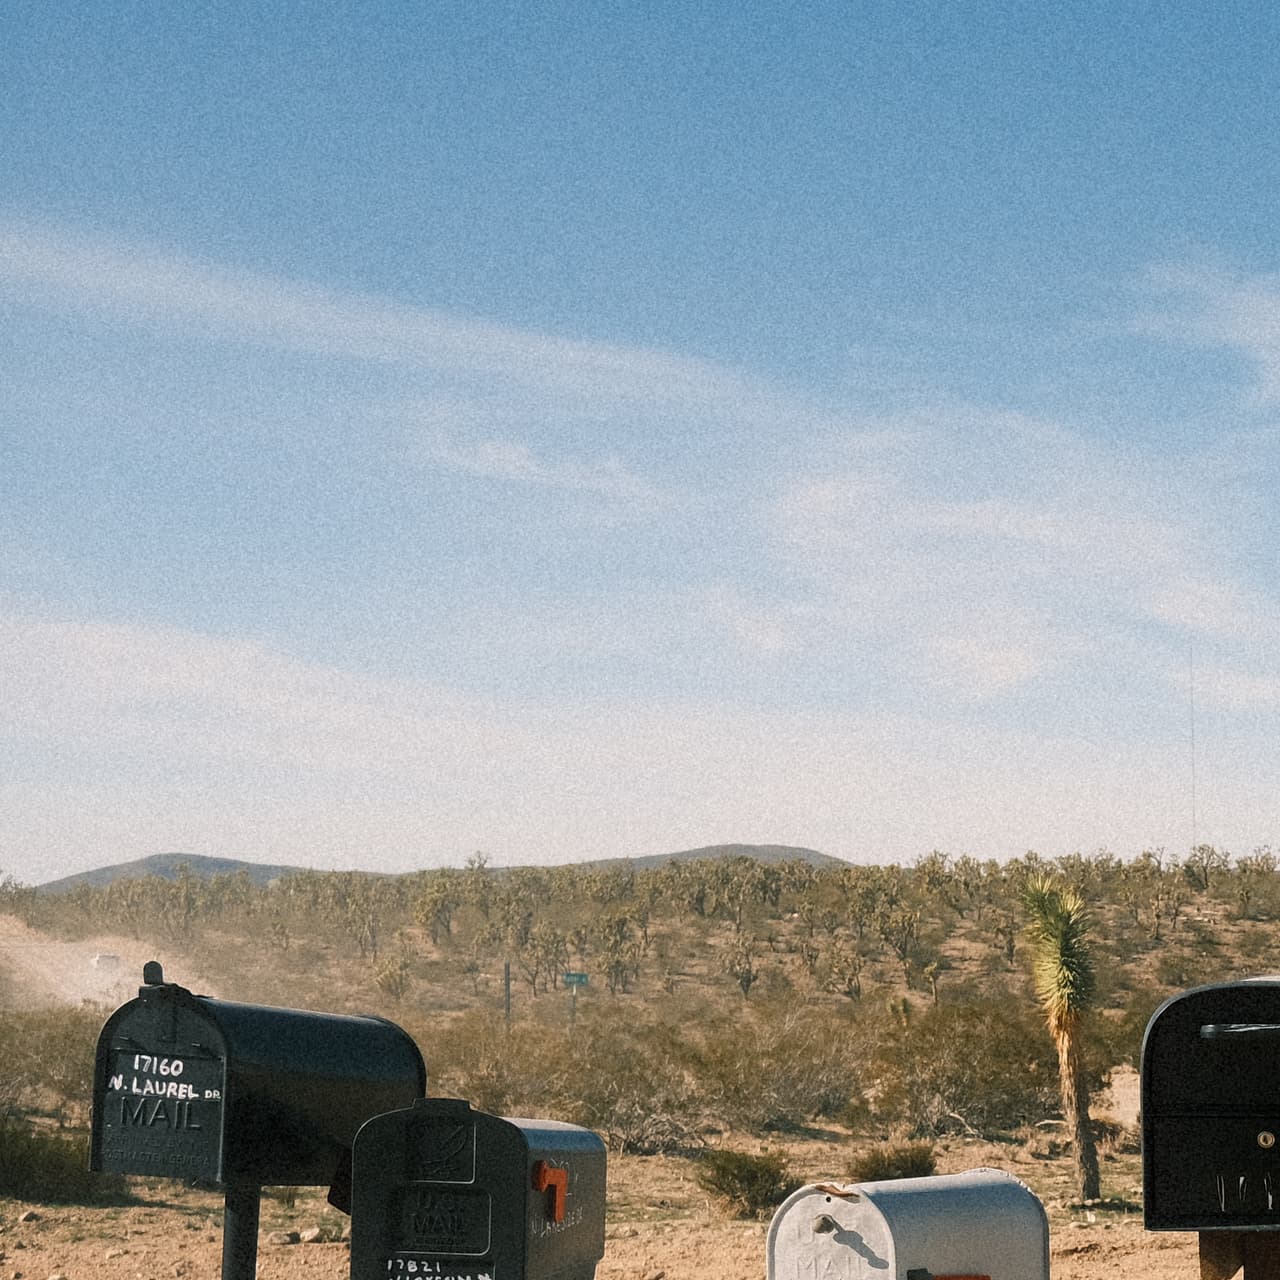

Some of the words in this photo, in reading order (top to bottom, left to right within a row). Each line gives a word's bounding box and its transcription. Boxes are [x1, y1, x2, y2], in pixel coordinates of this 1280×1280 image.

[134, 1054, 184, 1076] 17160
[132, 1076, 199, 1099] LAUREL
[120, 1096, 202, 1131] MAIL
[387, 1259, 440, 1272] 17821
